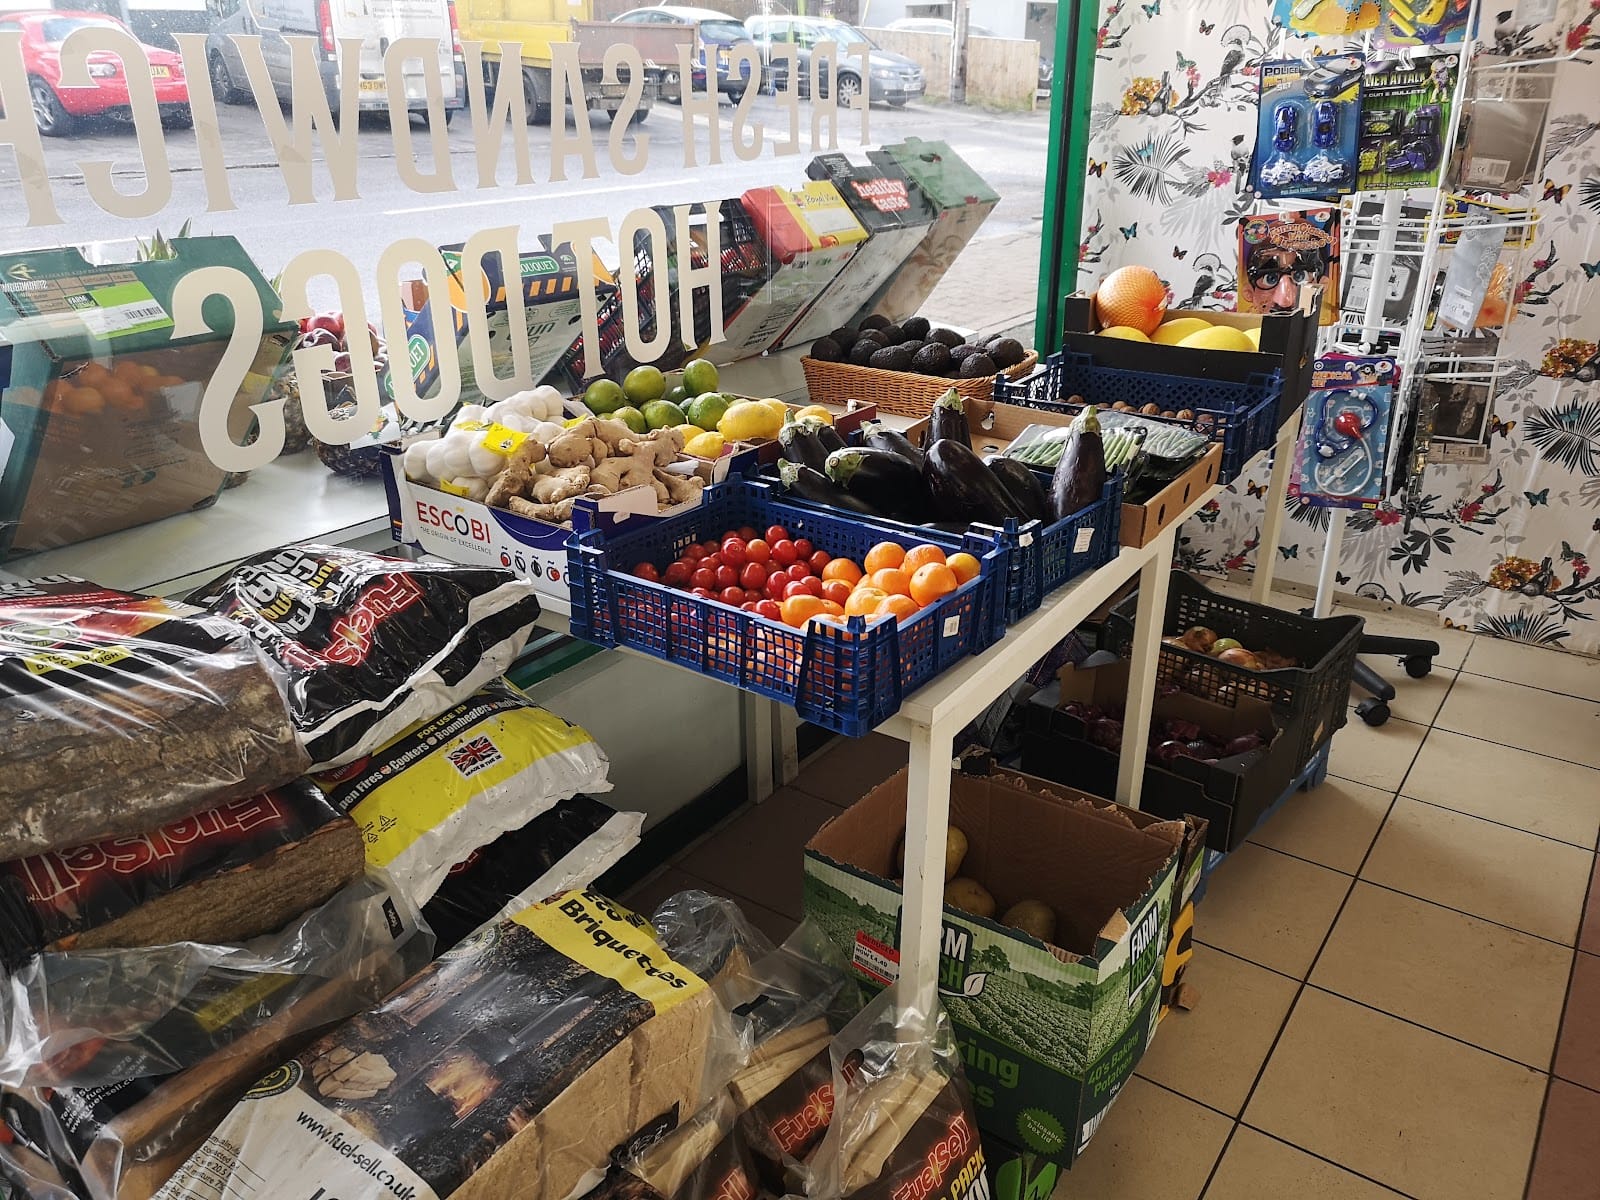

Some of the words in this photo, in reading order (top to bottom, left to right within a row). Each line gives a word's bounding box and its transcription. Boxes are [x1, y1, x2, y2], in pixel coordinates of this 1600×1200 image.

[1264, 66, 1301, 77] POLICE
[855, 178, 907, 197] healthy
[872, 195, 910, 210] taste
[519, 259, 555, 277] OUQUET
[416, 501, 492, 544] ESCOBI
[457, 539, 492, 555] EXCELLENCE
[416, 724, 437, 740] FOR
[434, 711, 457, 729] USE
[454, 703, 469, 716] IN
[337, 787, 358, 810] pen
[356, 771, 384, 793] Fires
[388, 741, 431, 771] Cookers
[433, 703, 491, 740] Roomheaters
[559, 898, 688, 990] Briquettes
[1130, 901, 1159, 963] FARM
[855, 947, 871, 958] NOW
[1130, 942, 1161, 993] FRESH
[61, 1105, 73, 1121] Tel:
[1022, 1111, 1064, 1144] re-closable
[1026, 1122, 1042, 1137] box
[1041, 1131, 1054, 1145] lid
[296, 1109, 417, 1200] www.fuel-sell.co.uk
[949, 1148, 986, 1200] PACK
